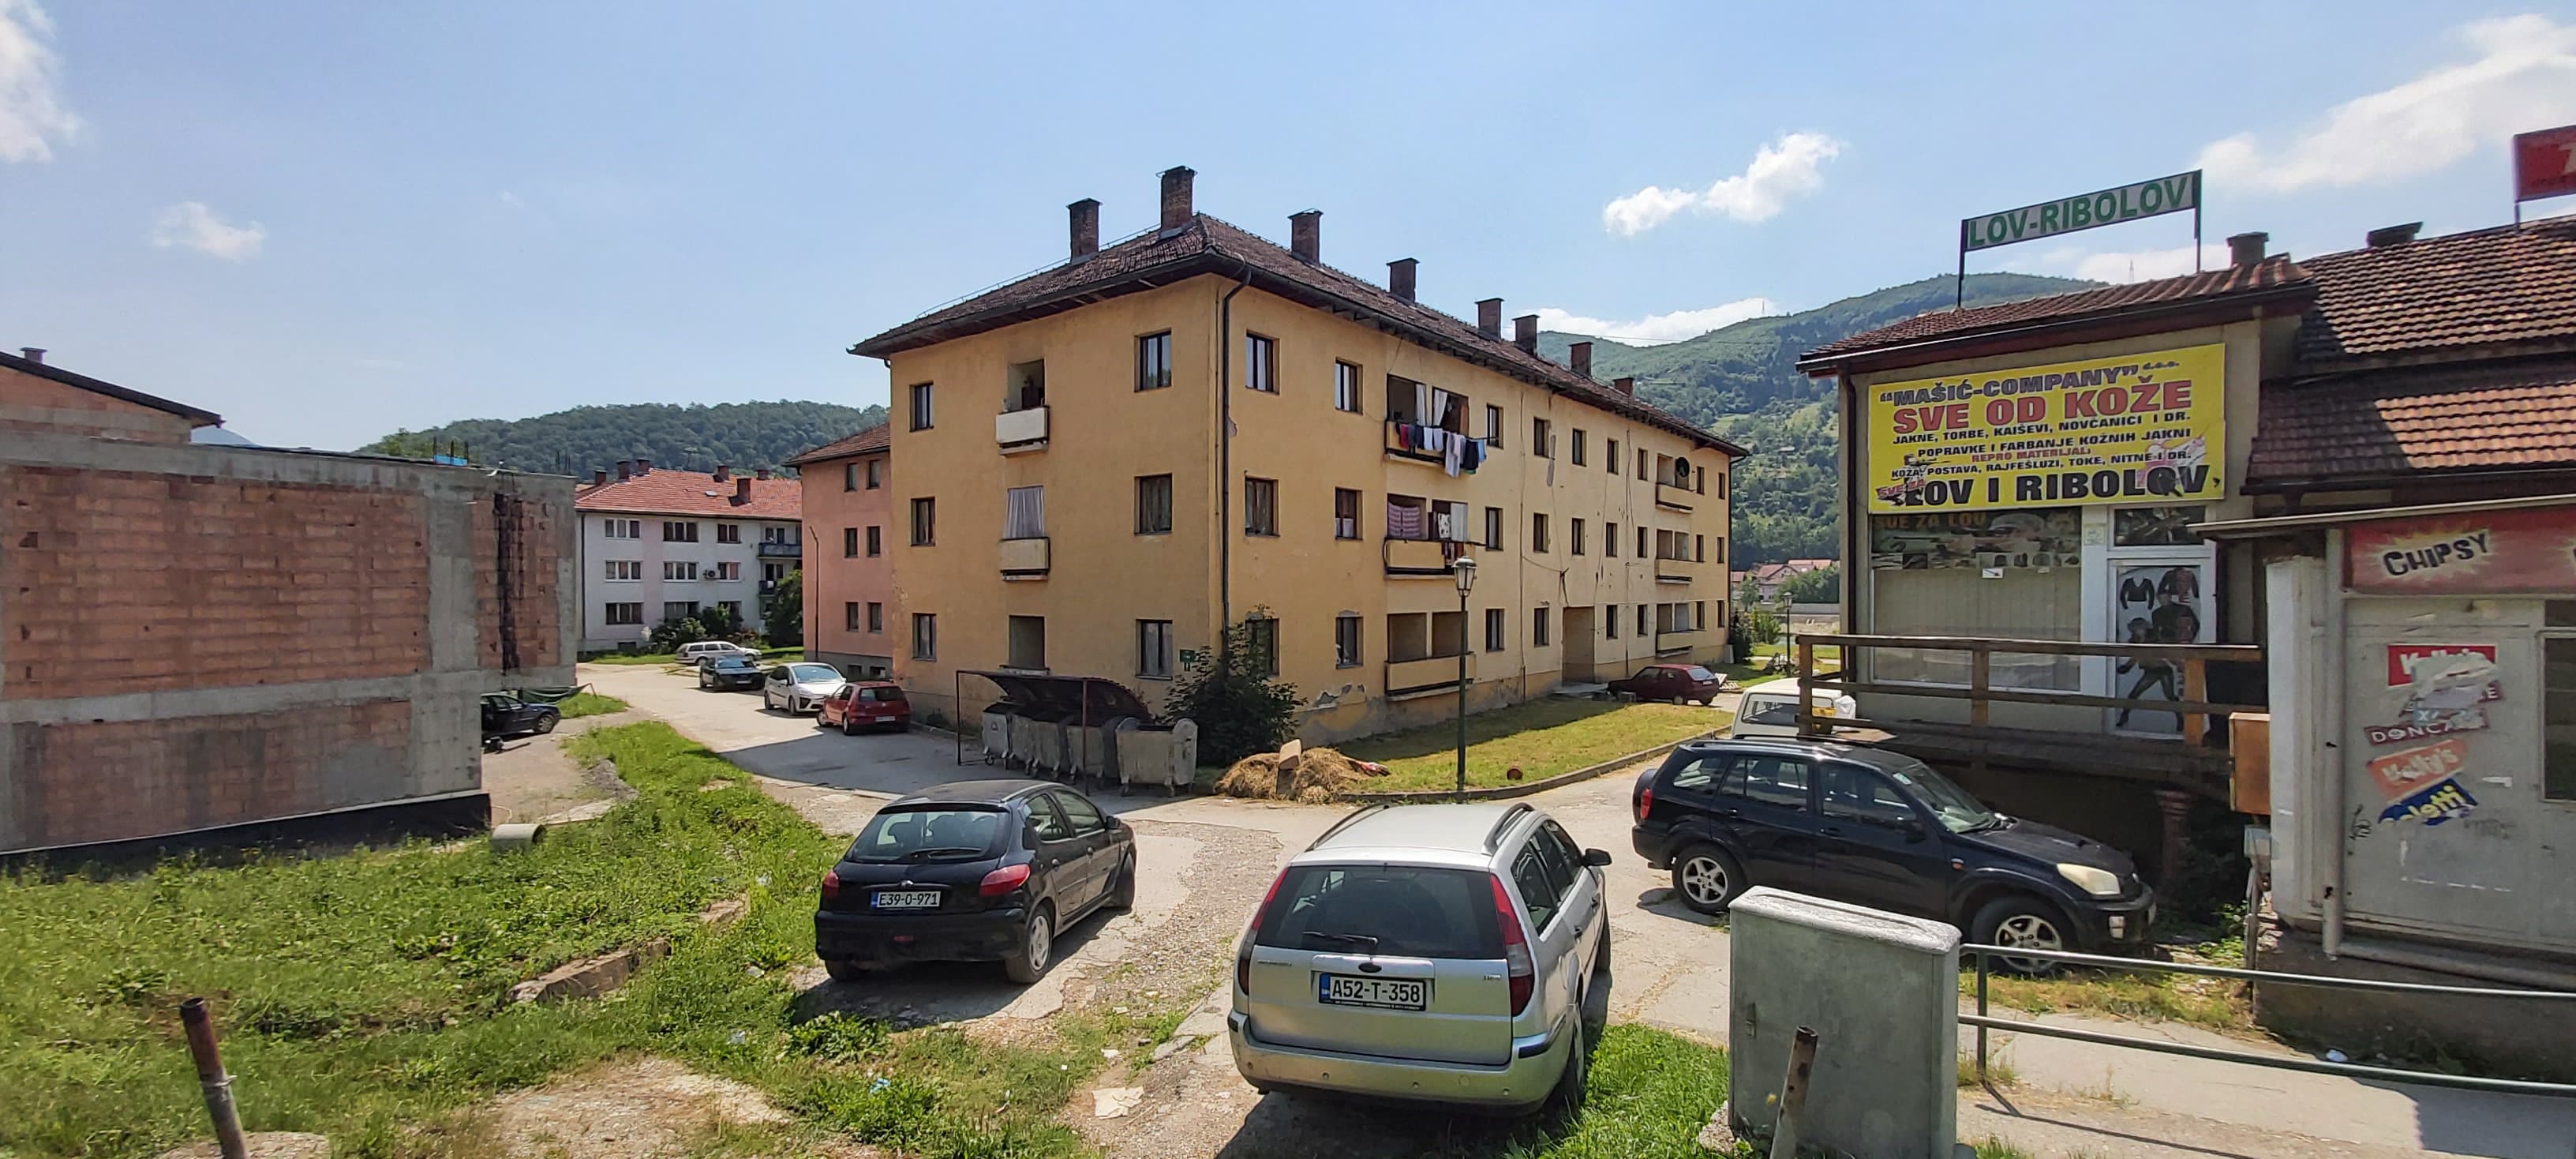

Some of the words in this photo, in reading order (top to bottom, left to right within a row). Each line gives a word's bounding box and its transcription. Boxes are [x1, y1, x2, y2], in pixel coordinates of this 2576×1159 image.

[1969, 176, 2188, 247] LOV-RIBOLOV
[1893, 403, 1969, 433] SVE
[1986, 396, 2046, 426] OD
[2065, 375, 2192, 418] KOŽE
[1893, 433, 1938, 444] JAKNE,
[1943, 429, 1989, 441] TORBE,
[1994, 423, 2054, 437] KAIŠEVI,
[2059, 416, 2142, 431] NOVČANICI
[2165, 411, 2191, 422] DR.
[1918, 444, 1986, 457] POPRAVKE
[1990, 443, 1995, 452] I
[2000, 437, 2074, 451] FARBANJE
[2141, 429, 2191, 441] JAKNI
[1971, 453, 2012, 463] REPRO
[1927, 465, 1982, 474] POSTAVA,
[2069, 457, 2106, 467] TOKE,
[2168, 451, 2192, 459] DR.
[1906, 478, 1975, 506] LOV
[1988, 478, 1999, 502] I
[2016, 464, 2210, 501] RIBOLOV
[2383, 533, 2488, 576] CHIPSY
[2372, 722, 2470, 743] DONC
[1332, 980, 1420, 1003] A52-T-358
